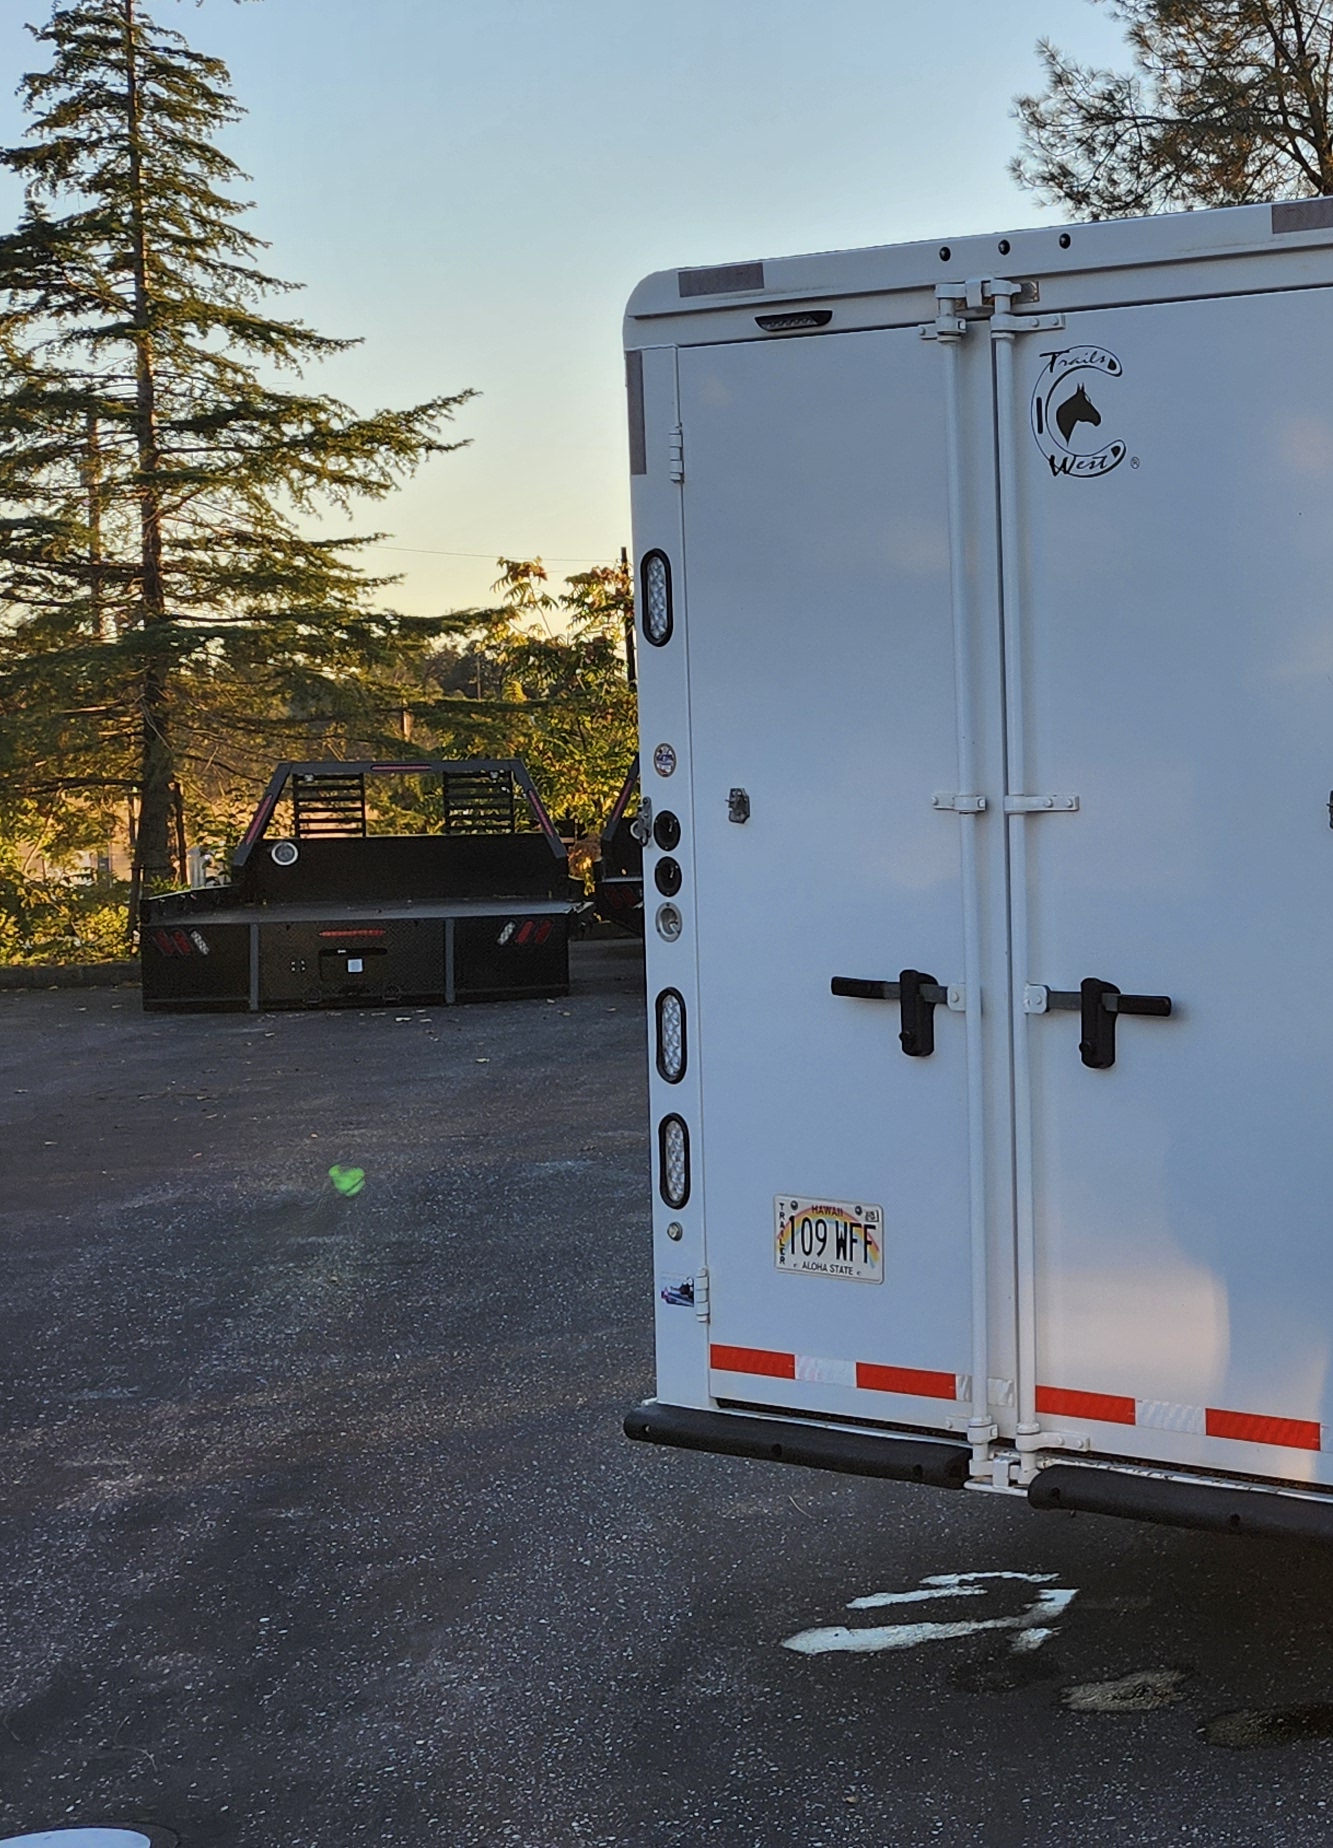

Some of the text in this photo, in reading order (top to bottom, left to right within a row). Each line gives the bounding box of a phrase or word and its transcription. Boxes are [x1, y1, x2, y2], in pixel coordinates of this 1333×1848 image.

[1039, 349, 1107, 373] Trails
[1049, 454, 1108, 477] West
[811, 1204, 844, 1217] HAWAII
[789, 1215, 876, 1264] 109 WFF
[801, 1261, 854, 1276] ALOHA STATE
